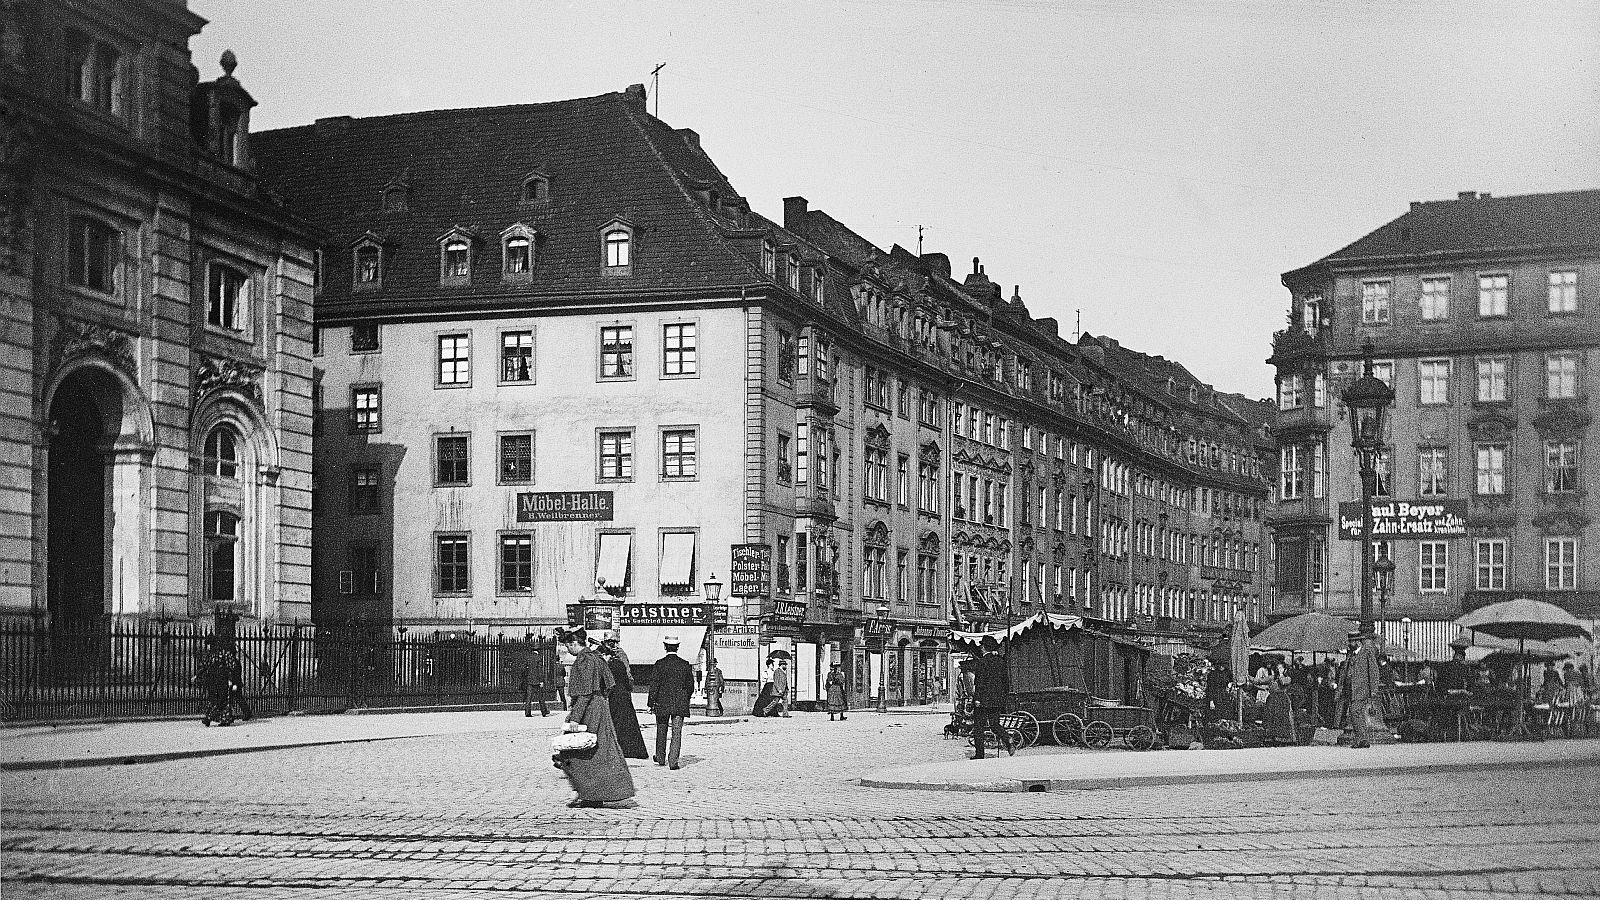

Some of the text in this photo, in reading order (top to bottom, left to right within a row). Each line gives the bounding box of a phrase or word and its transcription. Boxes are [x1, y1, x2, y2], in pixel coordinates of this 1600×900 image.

[522, 494, 609, 512] Möbel-Halle.
[1371, 502, 1444, 520] aul Beyer
[733, 582, 760, 594] Lager.
